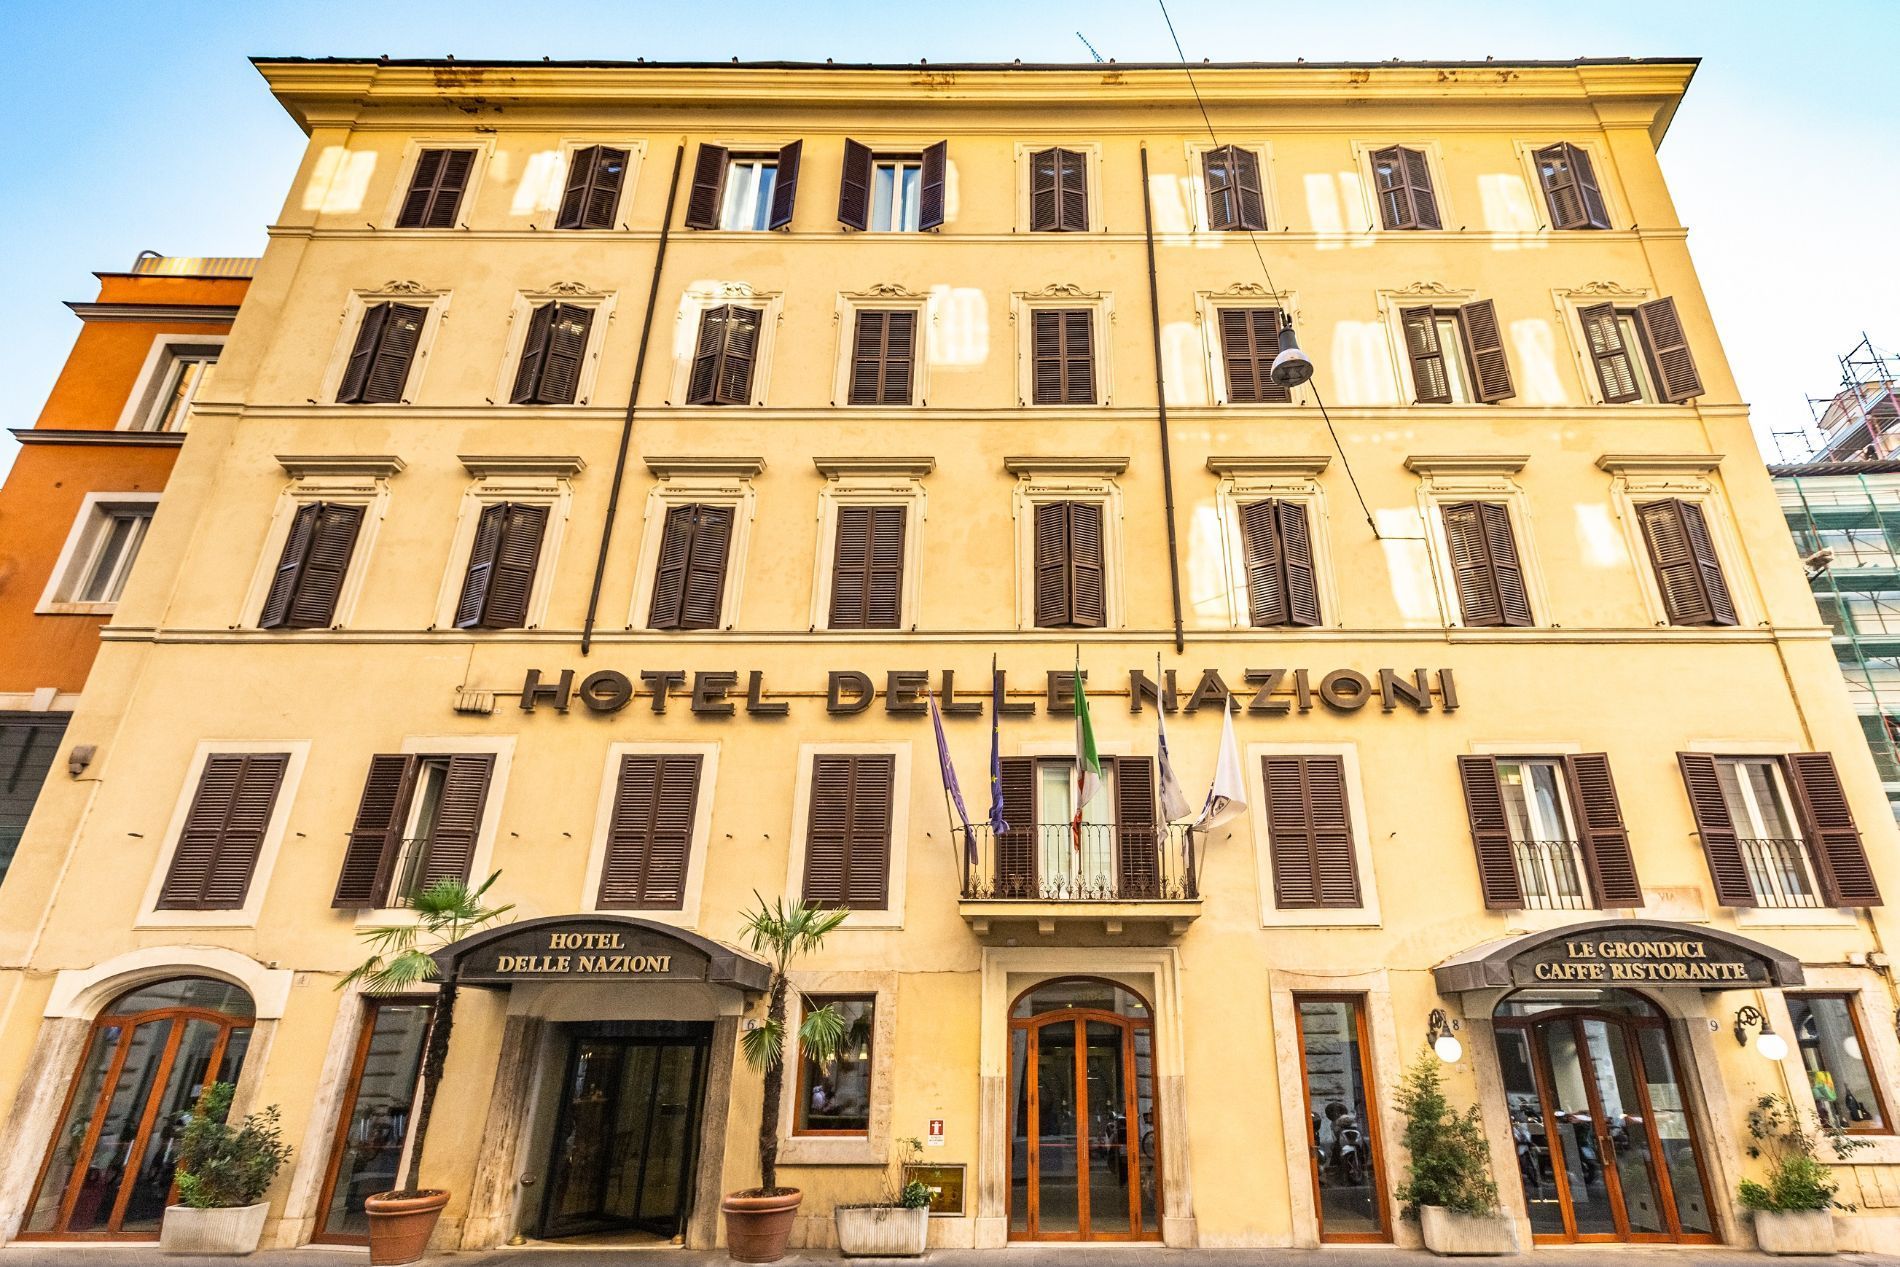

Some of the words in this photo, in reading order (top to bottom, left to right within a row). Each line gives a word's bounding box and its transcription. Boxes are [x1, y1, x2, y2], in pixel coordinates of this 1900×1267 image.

[519, 668, 790, 716] HOTEL
[826, 668, 1089, 716] DELLE
[1129, 668, 1459, 714] NAZIONI
[549, 933, 625, 950] HOTEL
[1566, 941, 1596, 959] LE
[1598, 941, 1706, 959] GRONDICI
[496, 955, 571, 973] DELLE
[577, 955, 671, 973] NAZIONI
[1609, 963, 1748, 981] RISTORANTE
[1452, 1019, 1460, 1031] 8
[1710, 1020, 1718, 1032] 9
